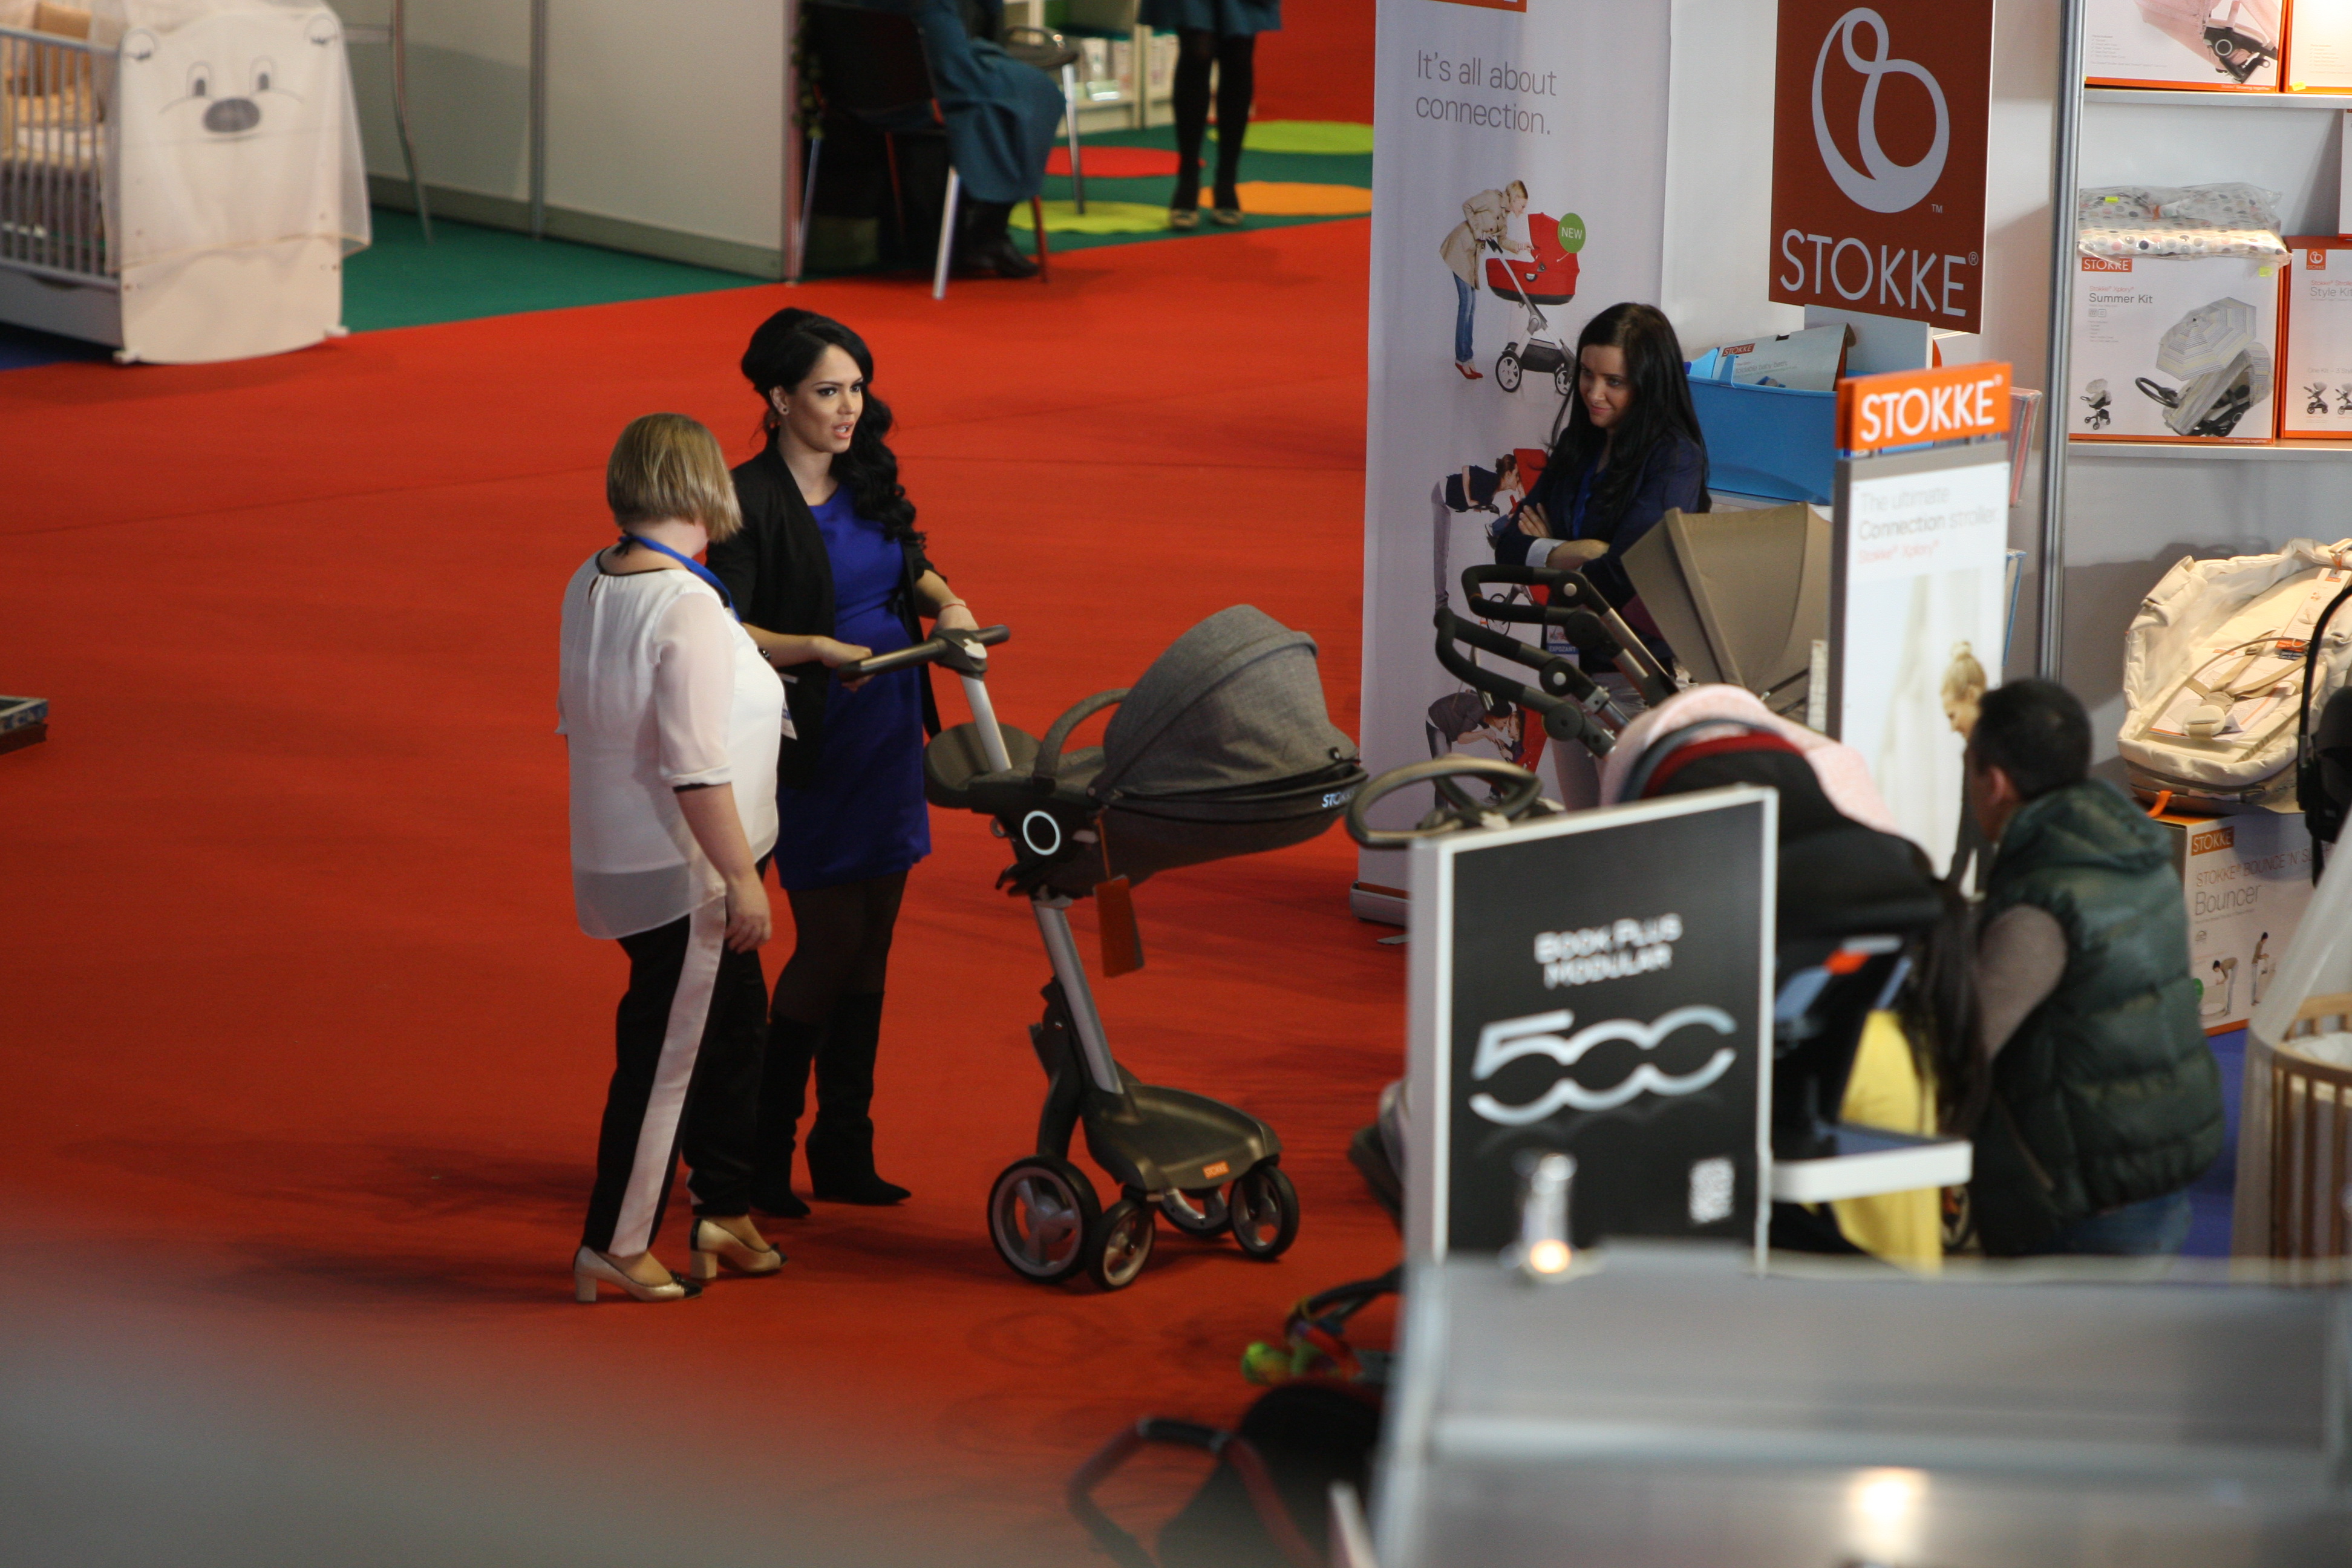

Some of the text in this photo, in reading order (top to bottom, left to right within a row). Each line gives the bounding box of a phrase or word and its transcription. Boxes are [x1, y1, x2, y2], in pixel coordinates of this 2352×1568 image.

[1417, 50, 1557, 97] It's all about
[1416, 96, 1551, 135] connection.
[1561, 227, 1583, 240] NEW
[2089, 293, 2153, 303] Summer Kit
[2310, 286, 2337, 298] Style
[1723, 344, 1753, 356] STOKKE
[1861, 486, 1951, 512] The ultimate
[1858, 514, 1946, 540] Connection
[2192, 830, 2232, 852] STOKKE
[2243, 854, 2285, 877] BOUNCE
[2195, 884, 2262, 916] Bouncer
[1534, 926, 1613, 964] BOOK
[1543, 942, 1673, 990] MODULAR
[1469, 1004, 1737, 1126] 500
